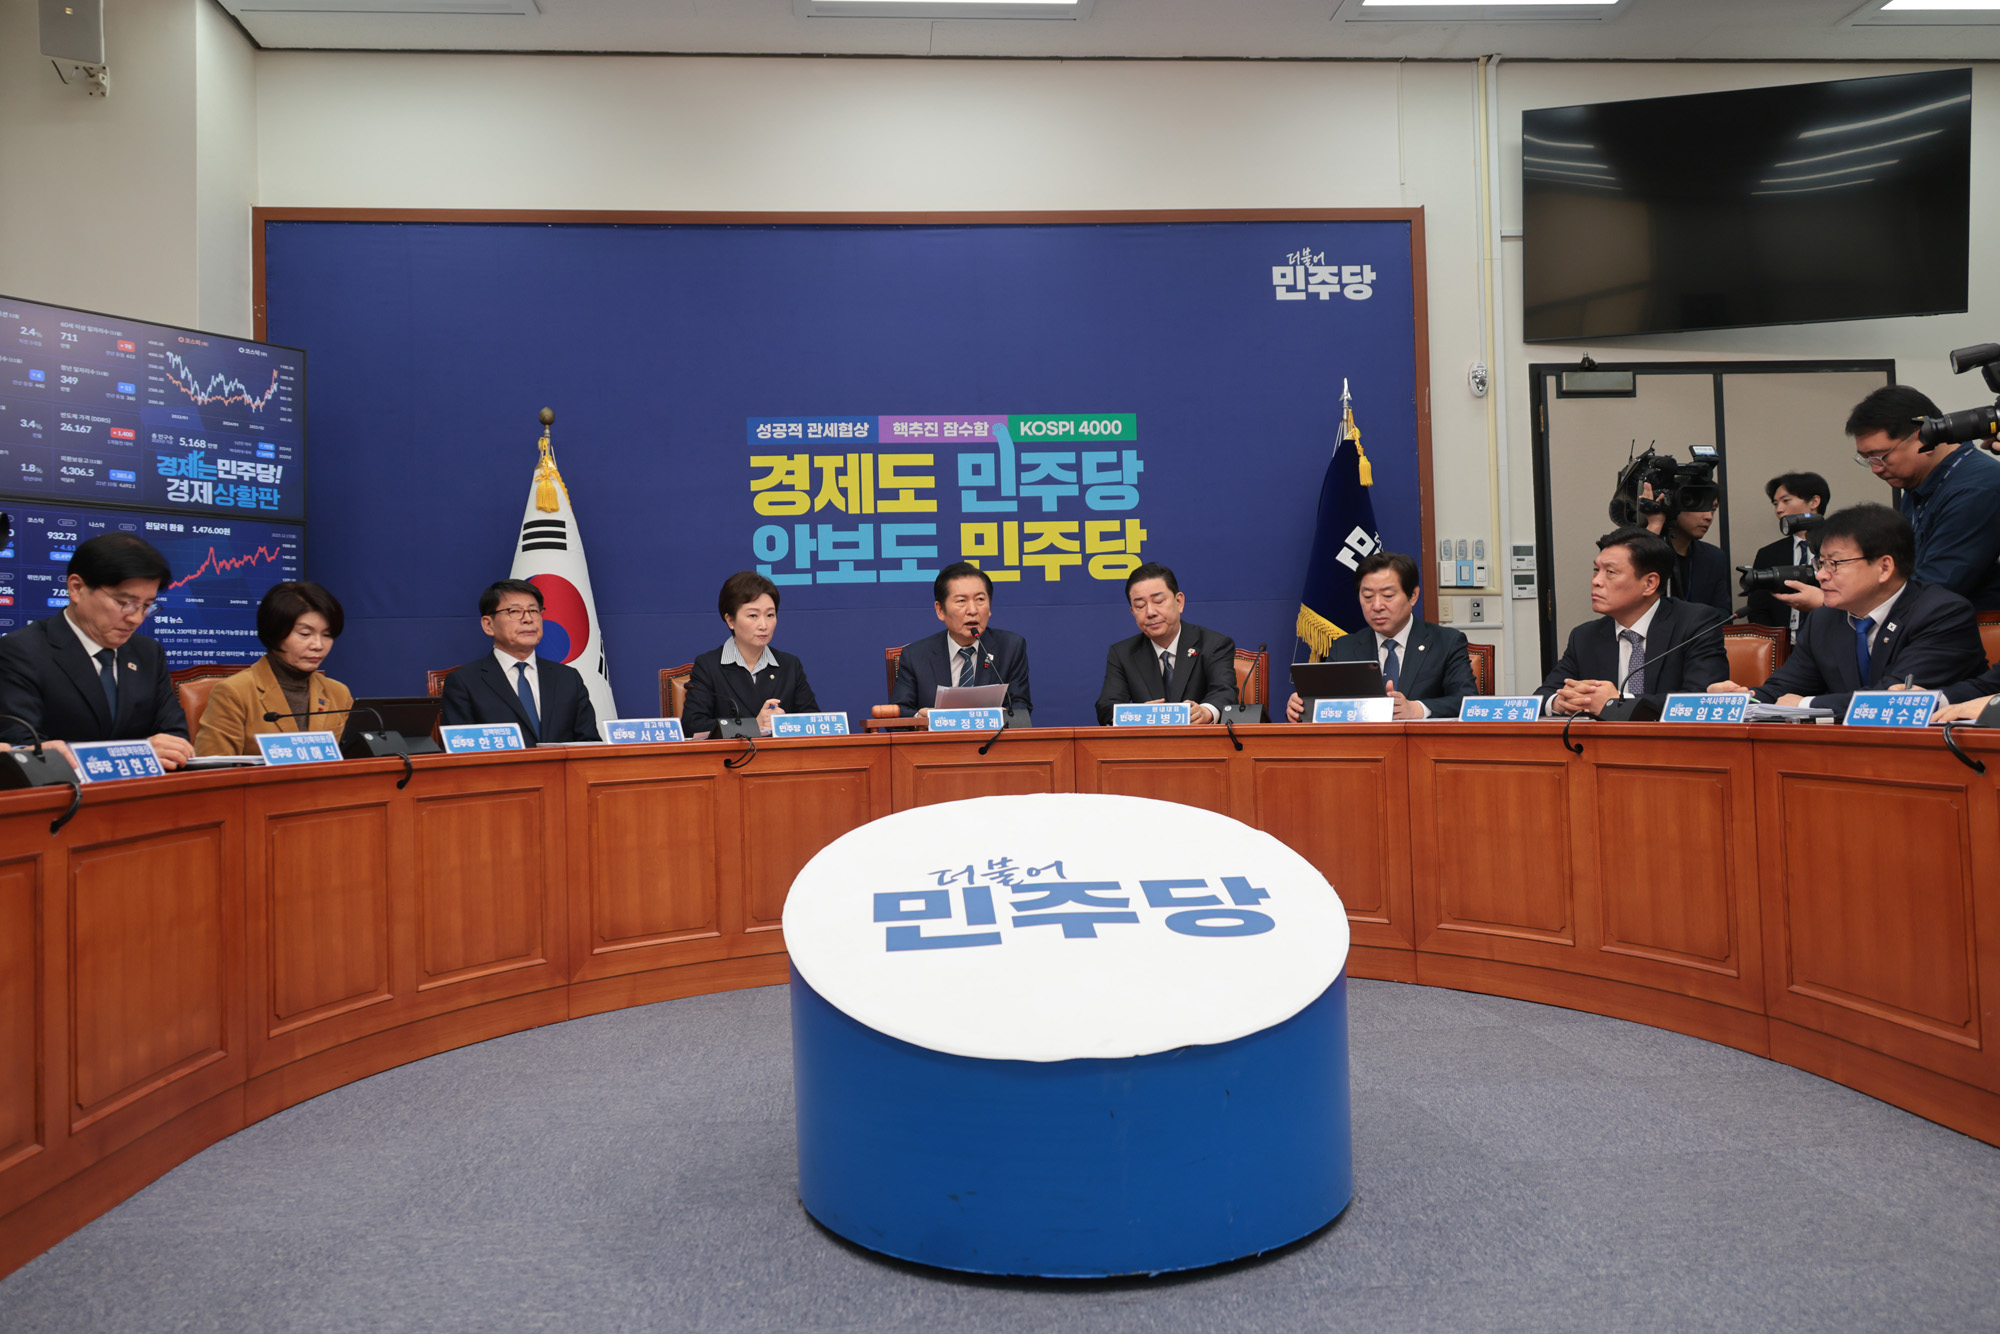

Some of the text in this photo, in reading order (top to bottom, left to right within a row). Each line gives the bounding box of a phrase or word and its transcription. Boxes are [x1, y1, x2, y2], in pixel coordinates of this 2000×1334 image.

[1286, 246, 1325, 267] 더불어
[1272, 264, 1377, 301] 민주당
[60, 332, 78, 342] 711
[60, 375, 79, 385] 349
[756, 422, 869, 439] 성공적 관세협상
[893, 421, 989, 438] 핵추진 잠수함
[1020, 420, 1122, 436] KOSPI 4000
[156, 450, 283, 484] 경제는 민주당!
[750, 450, 1144, 516] 경제도 민주당
[166, 478, 280, 510] 경제 상황판
[47, 531, 77, 541] 932.73
[753, 519, 1147, 586] 안보도 민주당
[169, 616, 183, 624] 뉴스
[1888, 696, 1929, 706] 수석대변인
[1146, 713, 1185, 724] 김병기
[1492, 708, 1535, 720] 조승래
[1696, 707, 1740, 721] 임호선
[1880, 708, 1927, 725] 박수현
[644, 721, 671, 729] 최고위원
[805, 723, 844, 735] 이언주
[961, 718, 999, 730] 정청래
[478, 736, 519, 749] 한정애
[640, 729, 679, 741] 서삼석
[114, 757, 159, 776] 김현정
[928, 857, 1067, 887] 더불어
[873, 876, 1276, 953] 민주당
